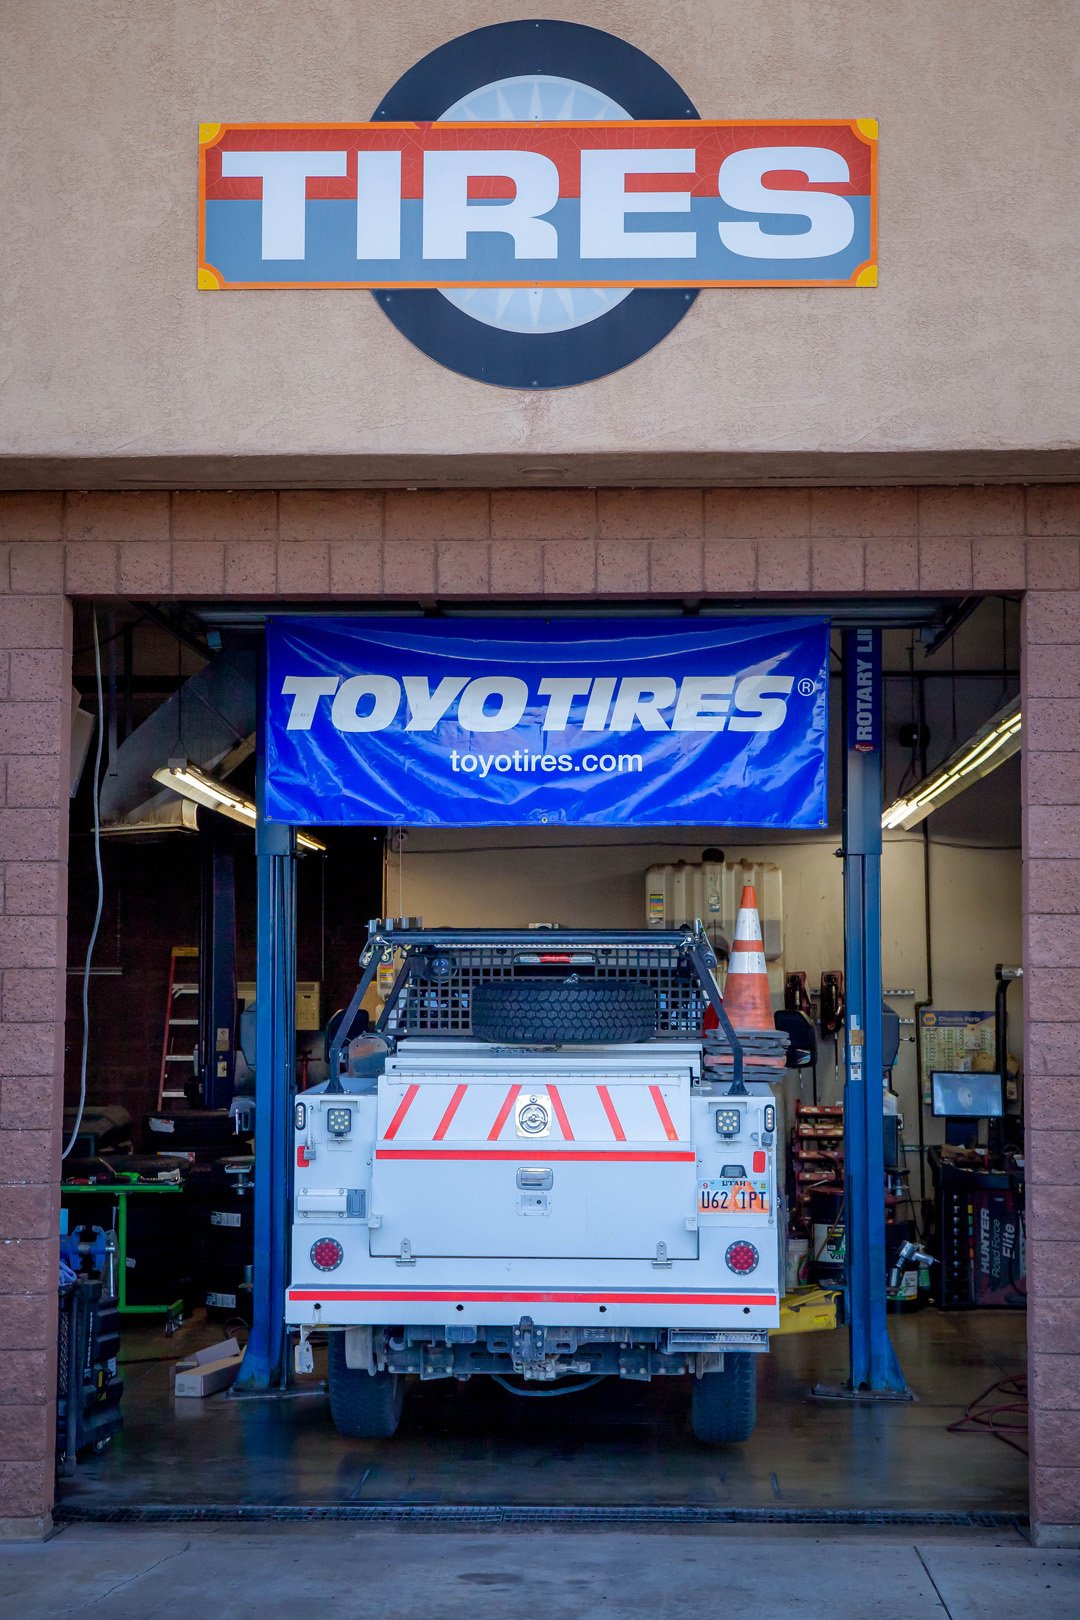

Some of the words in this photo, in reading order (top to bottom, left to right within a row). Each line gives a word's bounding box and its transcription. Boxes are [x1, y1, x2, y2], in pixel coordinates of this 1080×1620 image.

[222, 147, 855, 260] TIRES
[856, 659, 873, 741] ROTARY
[450, 749, 643, 778] toyotires.com
[702, 1191, 728, 1209] U62
[741, 1191, 766, 1209] 1PT
[980, 1208, 990, 1274] HUNTER
[991, 1218, 1001, 1249] Force
[1002, 1223, 1015, 1259] Elite
[991, 1249, 1001, 1278] Road
